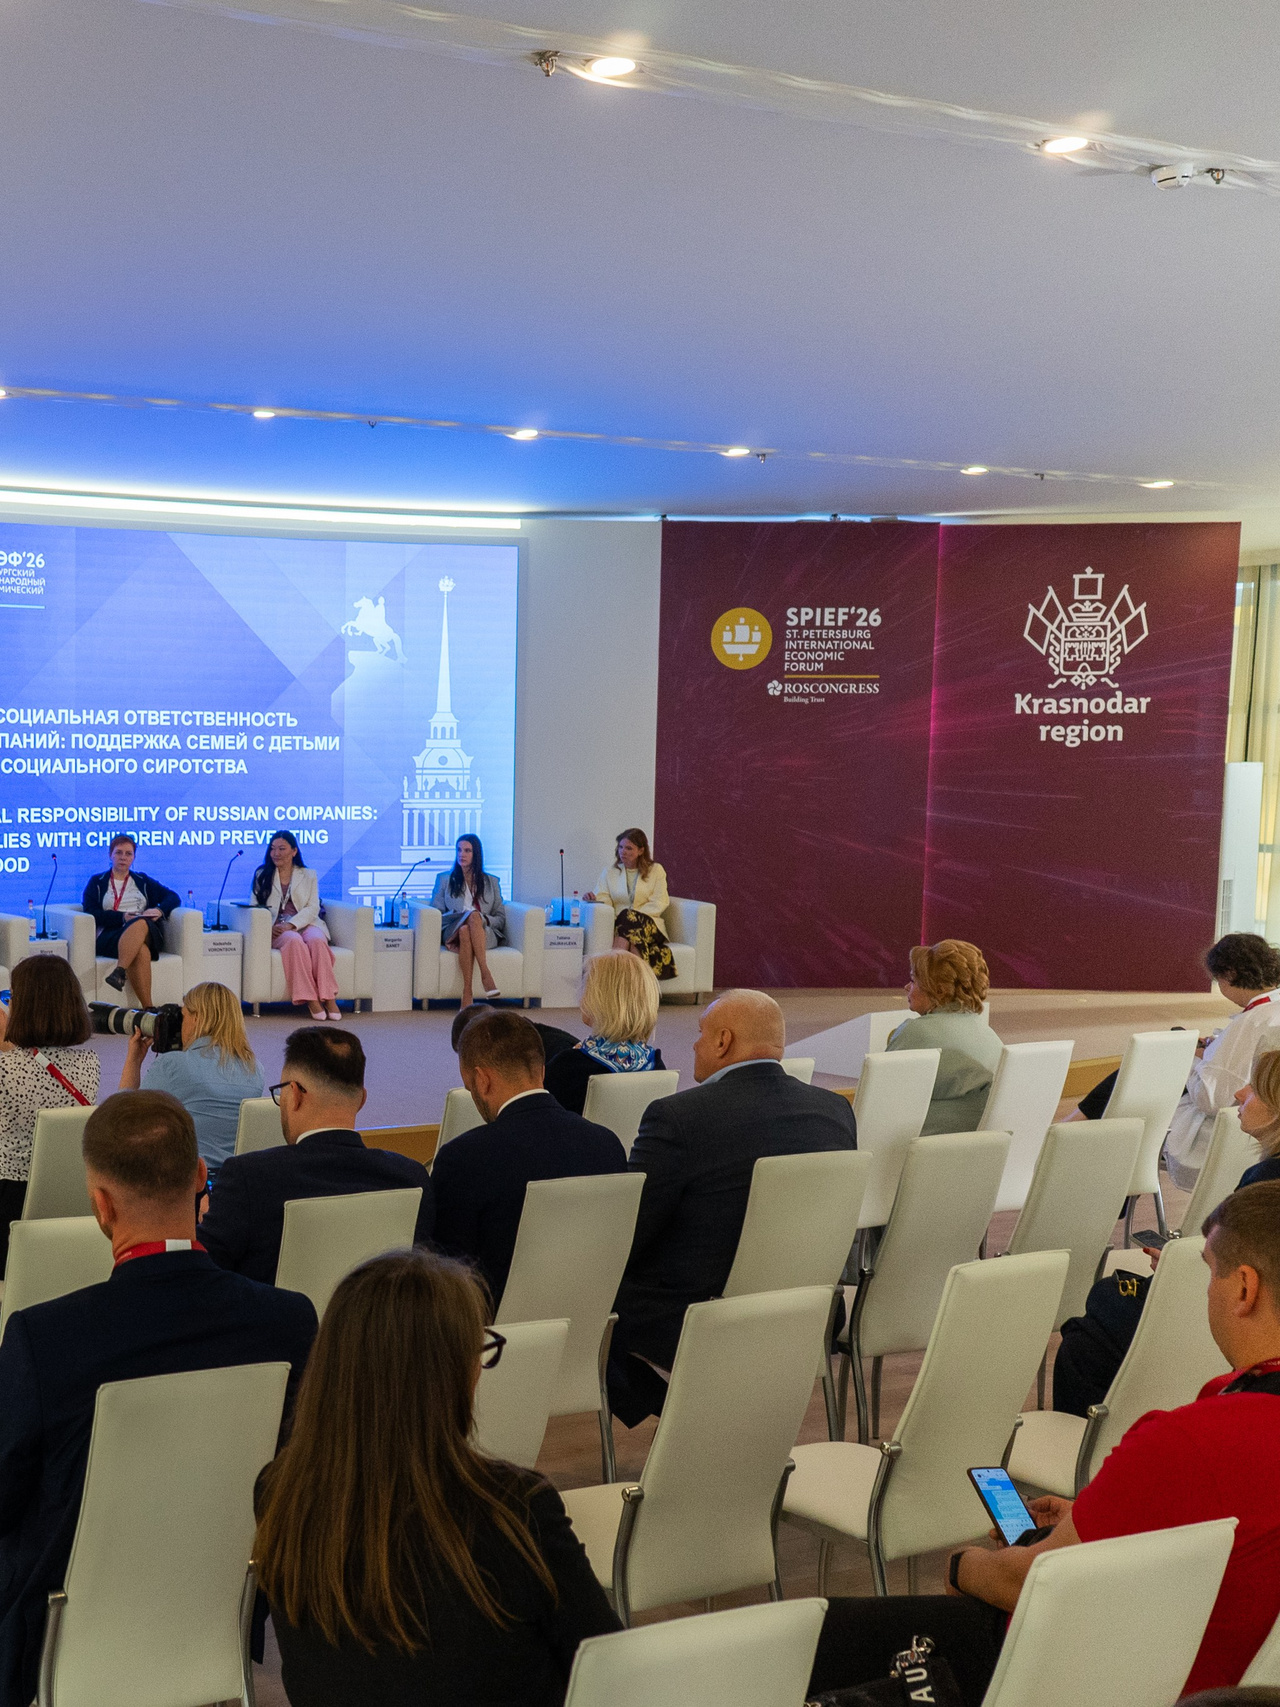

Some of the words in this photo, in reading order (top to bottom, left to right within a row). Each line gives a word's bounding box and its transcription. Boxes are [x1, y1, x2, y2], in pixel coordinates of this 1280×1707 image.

[785, 629, 800, 639] ST.
[802, 629, 871, 639] PETERSBURG
[785, 640, 875, 650] INTERNATIONAL
[784, 651, 845, 661] ECONOMIC
[784, 662, 824, 672] FORUM
[784, 683, 880, 694] ROSCONGRESS
[783, 696, 809, 704] Building
[1014, 690, 1151, 714] Krasnodar
[124, 709, 298, 727] ОТВЕТСТВЕННОСТЬ
[71, 733, 181, 752] ПОДДЕРЖКА
[186, 732, 248, 750] СЕМЕЙ
[252, 735, 265, 750] С
[268, 735, 340, 753] ДЕТЬМИ
[1039, 719, 1124, 748] region
[0, 757, 138, 777] СОЦИАЛЬНОГО
[142, 758, 248, 774] СИРОТСТВА
[17, 806, 160, 824] RESPONSIBILITY
[165, 806, 188, 822] OF
[193, 806, 269, 822] RUSSIAN
[273, 805, 378, 821] COMPANIES:
[36, 832, 81, 848] WITH
[85, 830, 174, 847] CHDREN
[178, 830, 215, 846] AND
[220, 829, 329, 845] PREVETING
